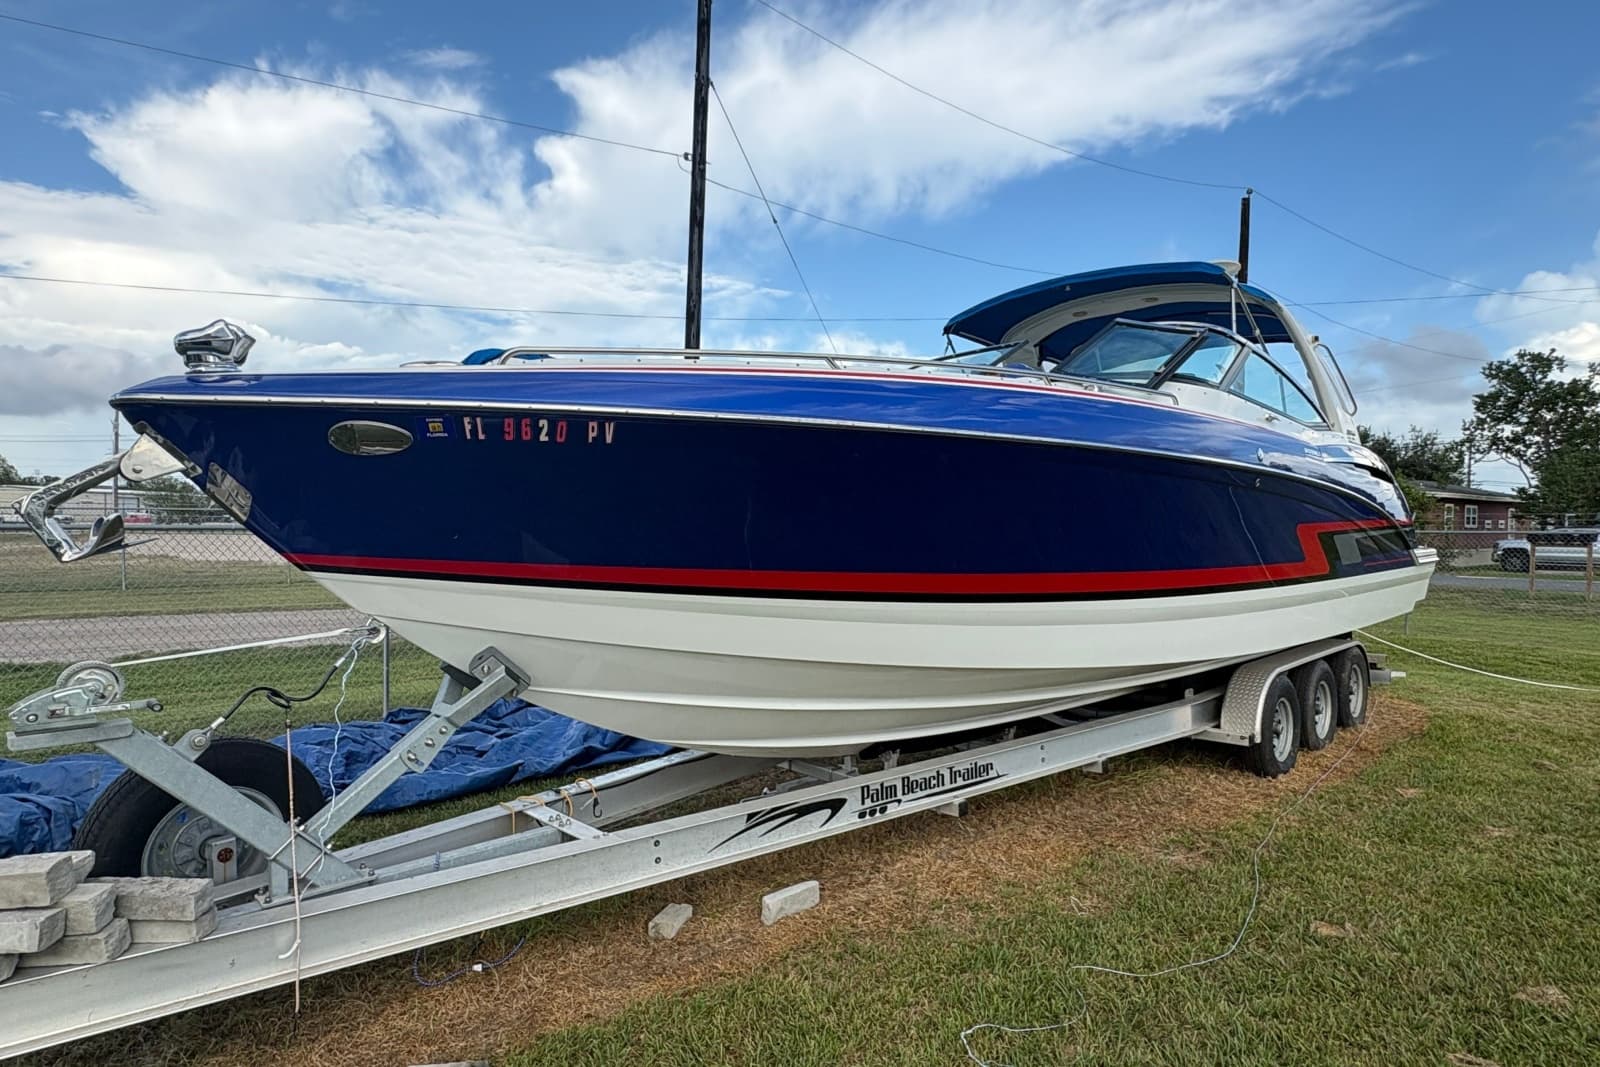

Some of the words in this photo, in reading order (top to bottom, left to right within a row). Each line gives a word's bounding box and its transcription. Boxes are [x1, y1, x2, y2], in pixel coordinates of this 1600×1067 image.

[463, 416, 486, 440] FL
[504, 417, 567, 443] 9620
[588, 421, 614, 444] PV
[860, 782, 898, 806] Palm
[901, 770, 945, 797] Beach
[946, 761, 994, 786] Trailer
